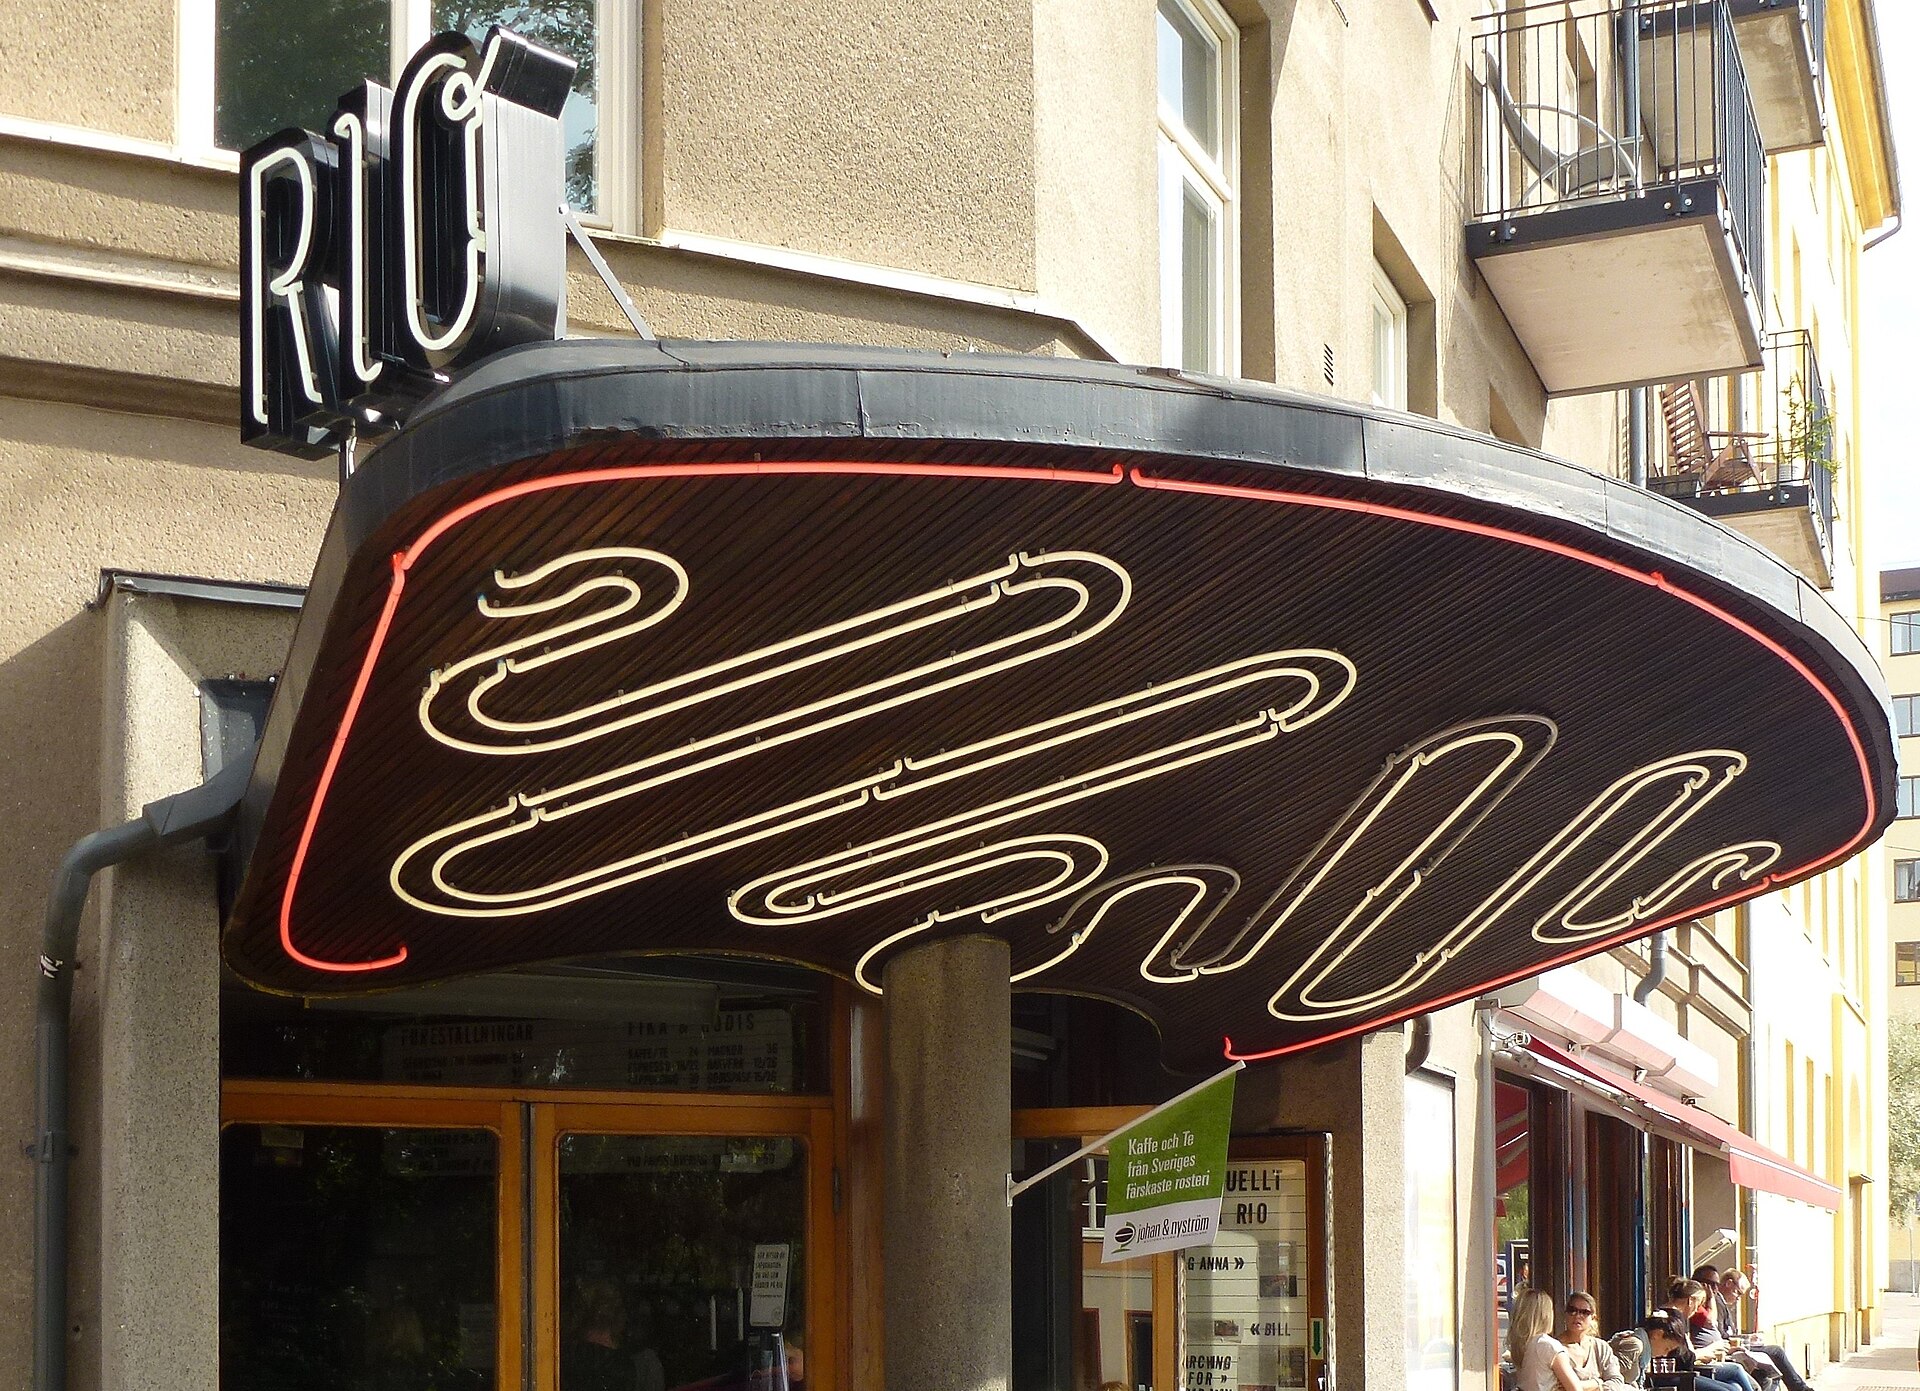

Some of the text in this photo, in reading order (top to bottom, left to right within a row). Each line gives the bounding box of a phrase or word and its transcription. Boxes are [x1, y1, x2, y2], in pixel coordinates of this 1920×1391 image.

[246, 30, 502, 440] RIO
[1128, 1130, 1195, 1156] Kaffe och Te
[1127, 1154, 1196, 1178] från Sveriges
[1126, 1170, 1210, 1200] färskaste rosteri
[1226, 1169, 1282, 1192] UELLT
[1236, 1202, 1268, 1225] RIO
[1137, 1222, 1161, 1244] johan
[1162, 1218, 1170, 1236] &
[1171, 1214, 1210, 1239] nyström
[1187, 1255, 1230, 1272] G ANNA
[1264, 1322, 1291, 1337] BILL
[1188, 1371, 1213, 1386] FOR
